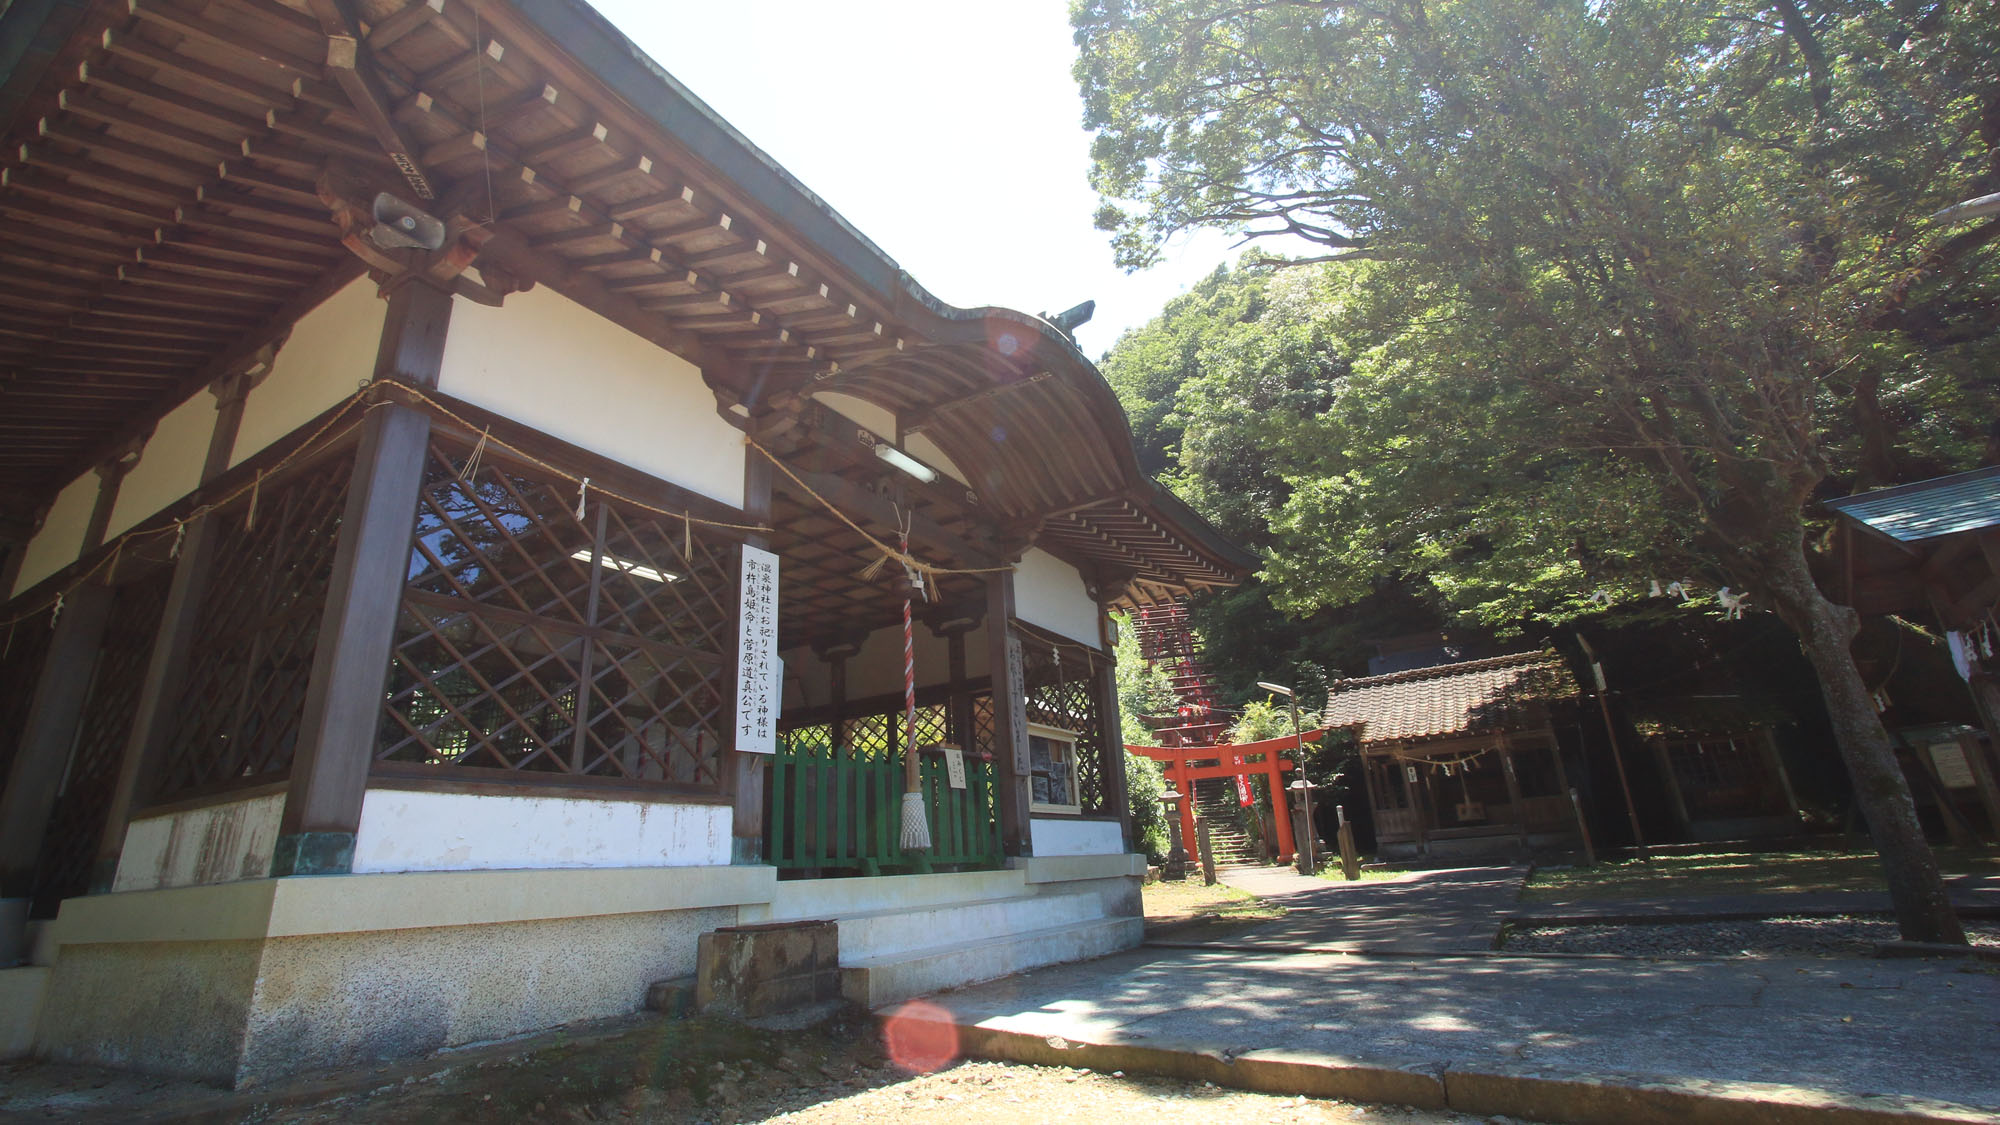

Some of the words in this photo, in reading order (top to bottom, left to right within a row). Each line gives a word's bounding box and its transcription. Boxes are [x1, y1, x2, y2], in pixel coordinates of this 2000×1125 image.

[741, 559, 756, 737] 市杵島姫命と菅原道真公です
[757, 562, 772, 738] 温泉神社にお祀りされている神様は
